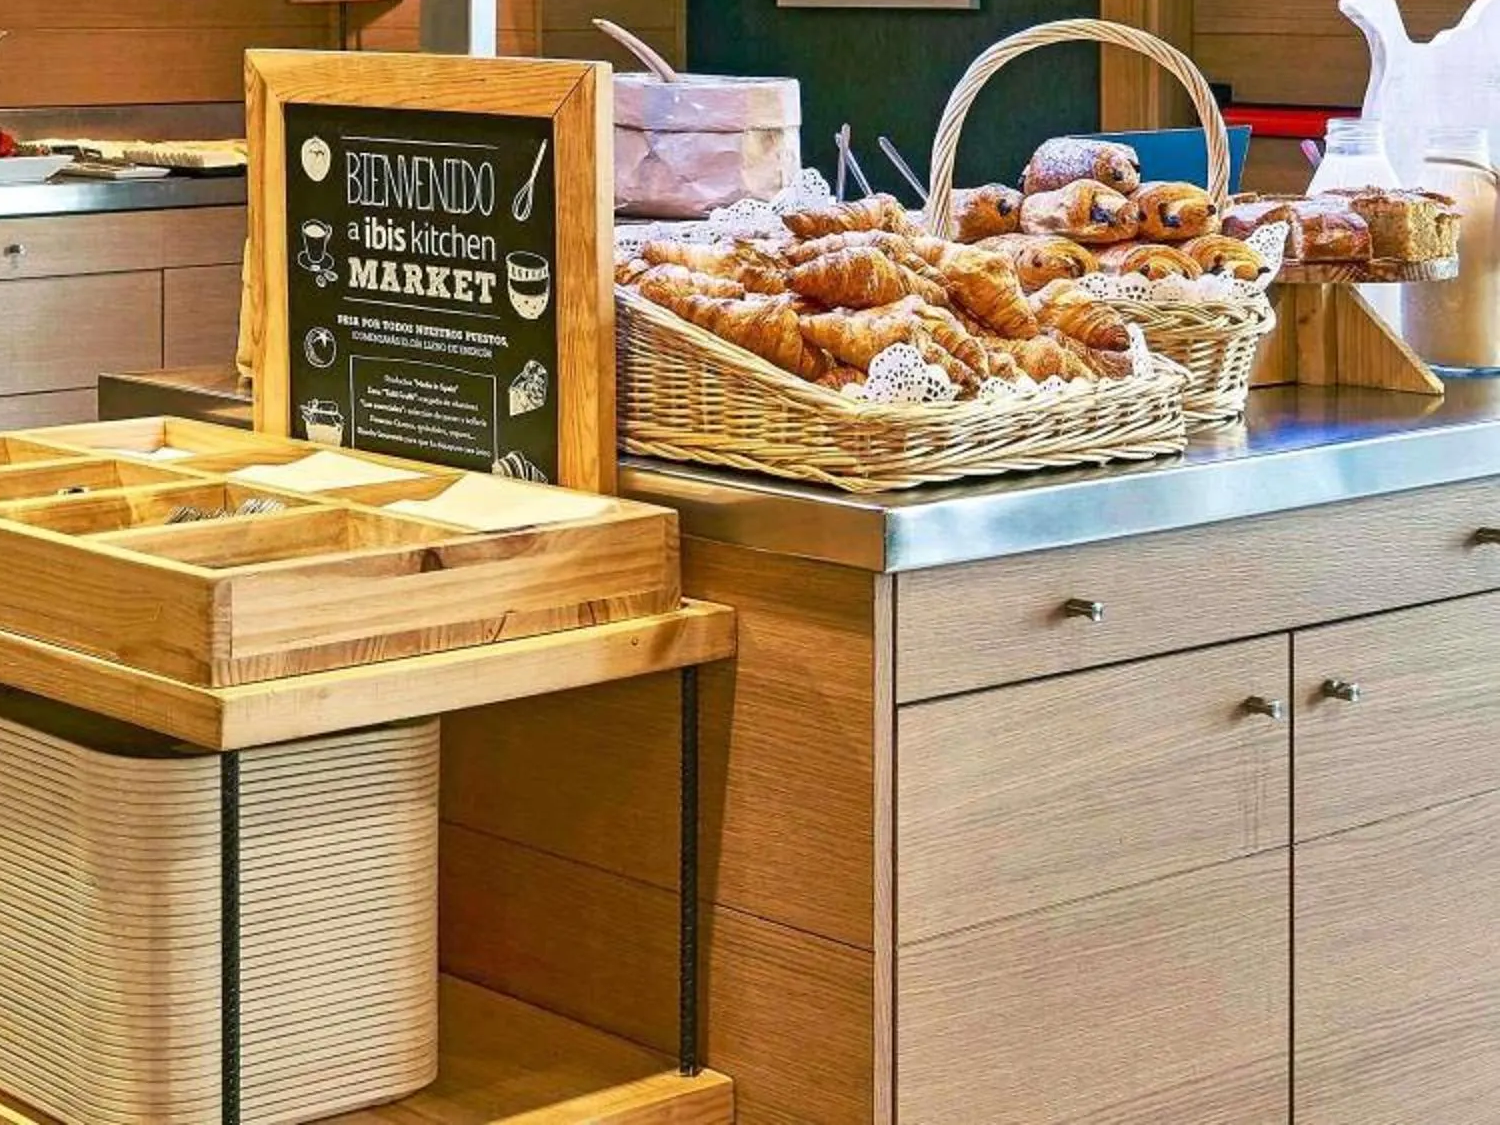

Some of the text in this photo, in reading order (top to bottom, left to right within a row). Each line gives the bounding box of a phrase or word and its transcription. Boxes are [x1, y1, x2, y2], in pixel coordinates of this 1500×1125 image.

[345, 151, 496, 217] BIENVENIDO
[347, 216, 497, 262] a ibis kitchen
[347, 256, 497, 304] MARKET
